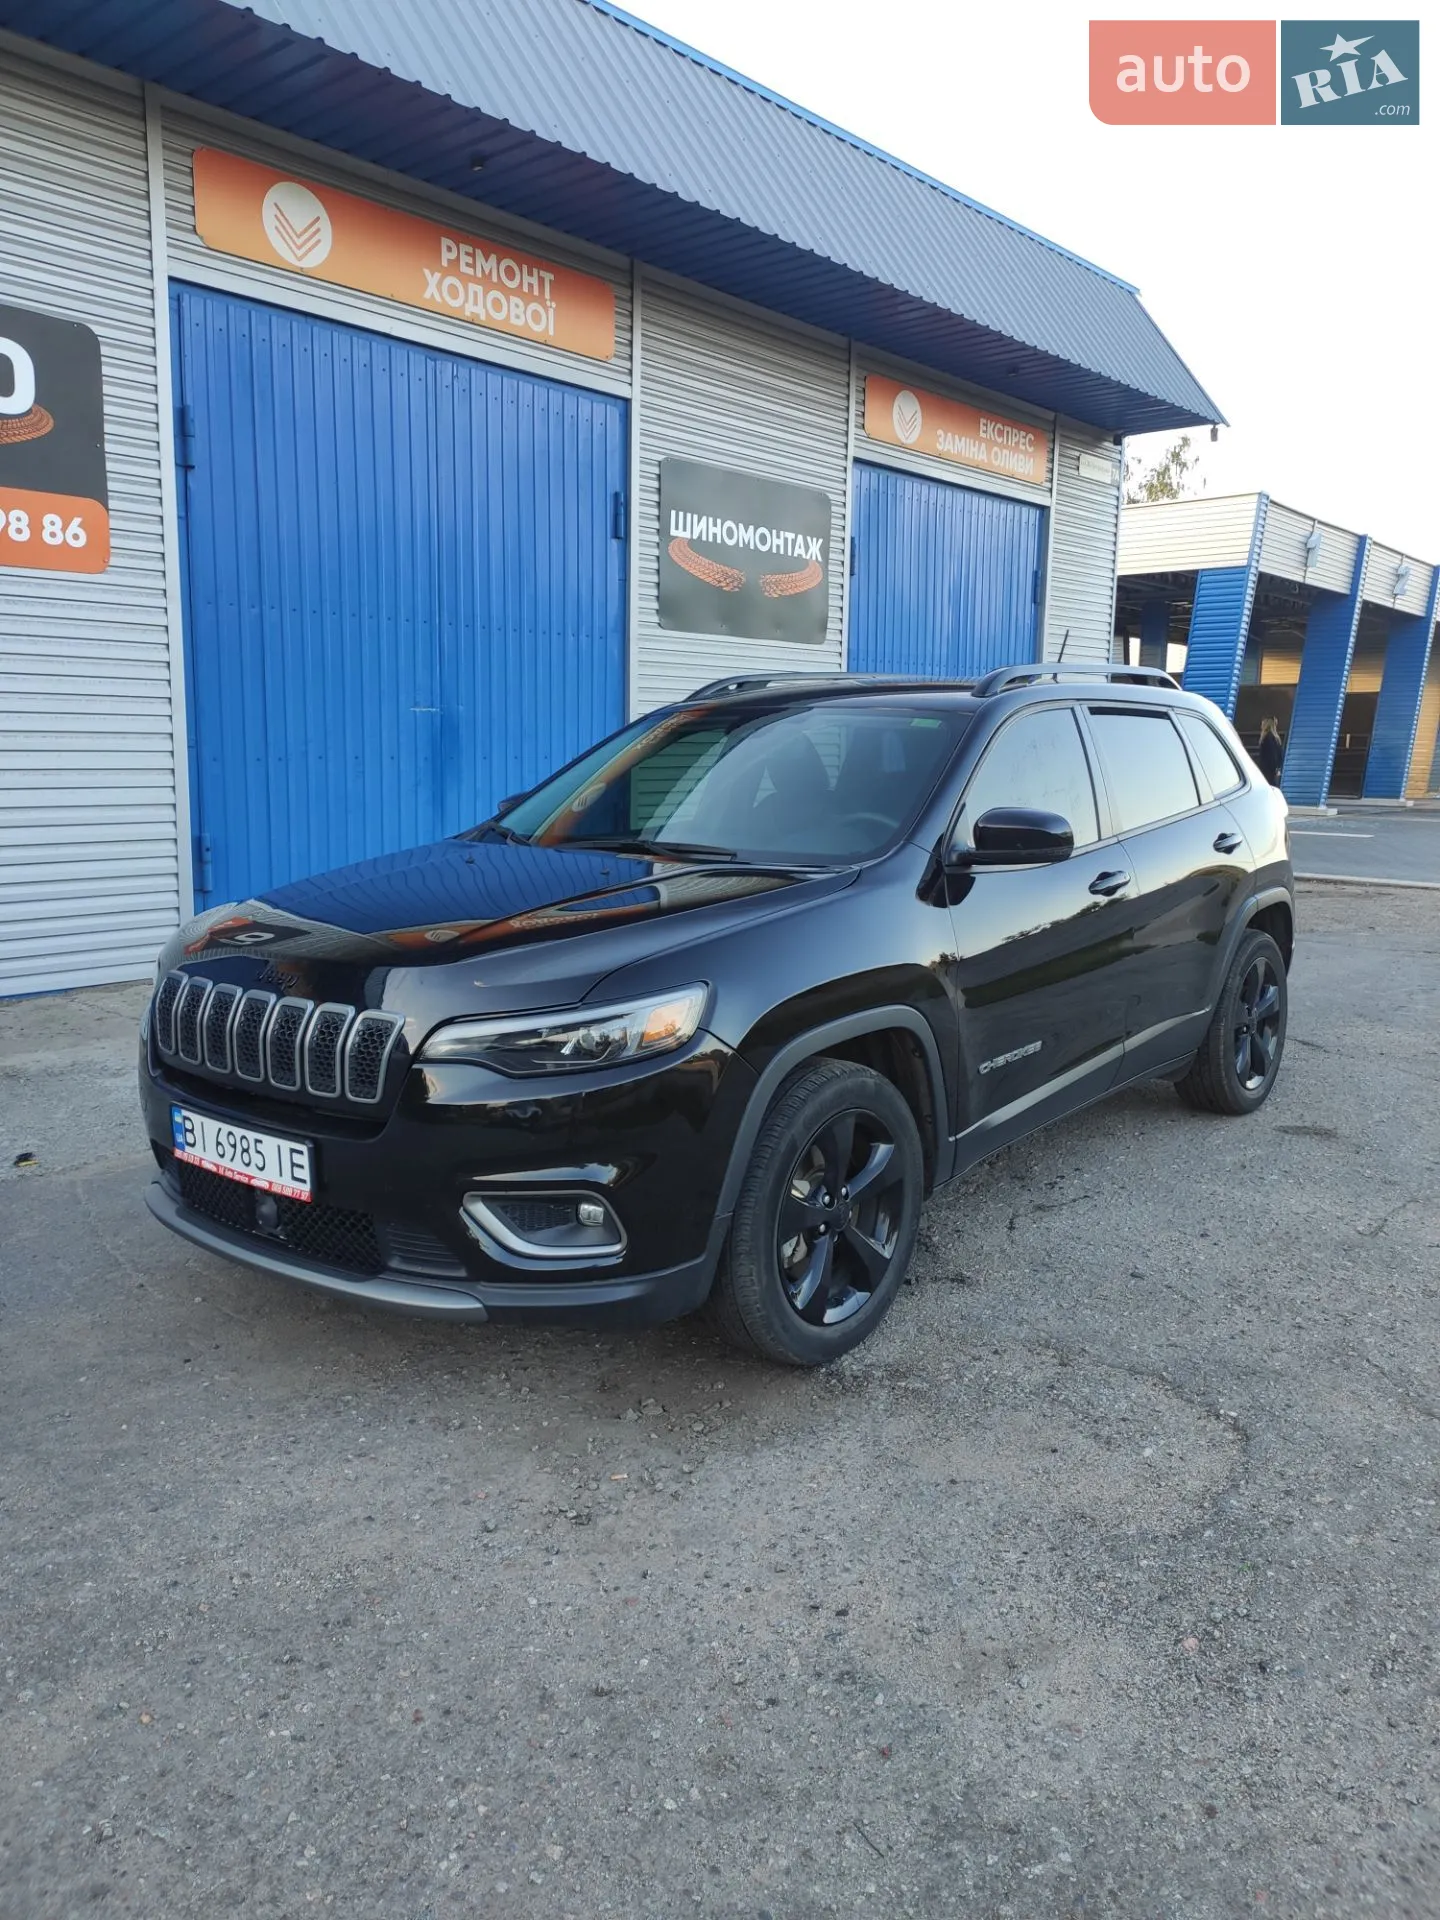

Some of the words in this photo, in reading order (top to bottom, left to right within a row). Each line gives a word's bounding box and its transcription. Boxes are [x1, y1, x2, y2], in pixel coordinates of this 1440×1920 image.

[440, 236, 555, 301] РЕМОНТ
[423, 268, 557, 337] ХОДОВОЇ
[936, 428, 988, 464] ЗАМІНА
[991, 446, 1035, 476] ОЛИВИ
[980, 417, 1035, 452] ЕКСПРЕС
[42, 513, 88, 549] 86
[670, 509, 824, 562] ШИНОМОНТАЖ
[183, 1115, 206, 1153] BI
[215, 1127, 266, 1172] 6985
[278, 1144, 307, 1185] IE
